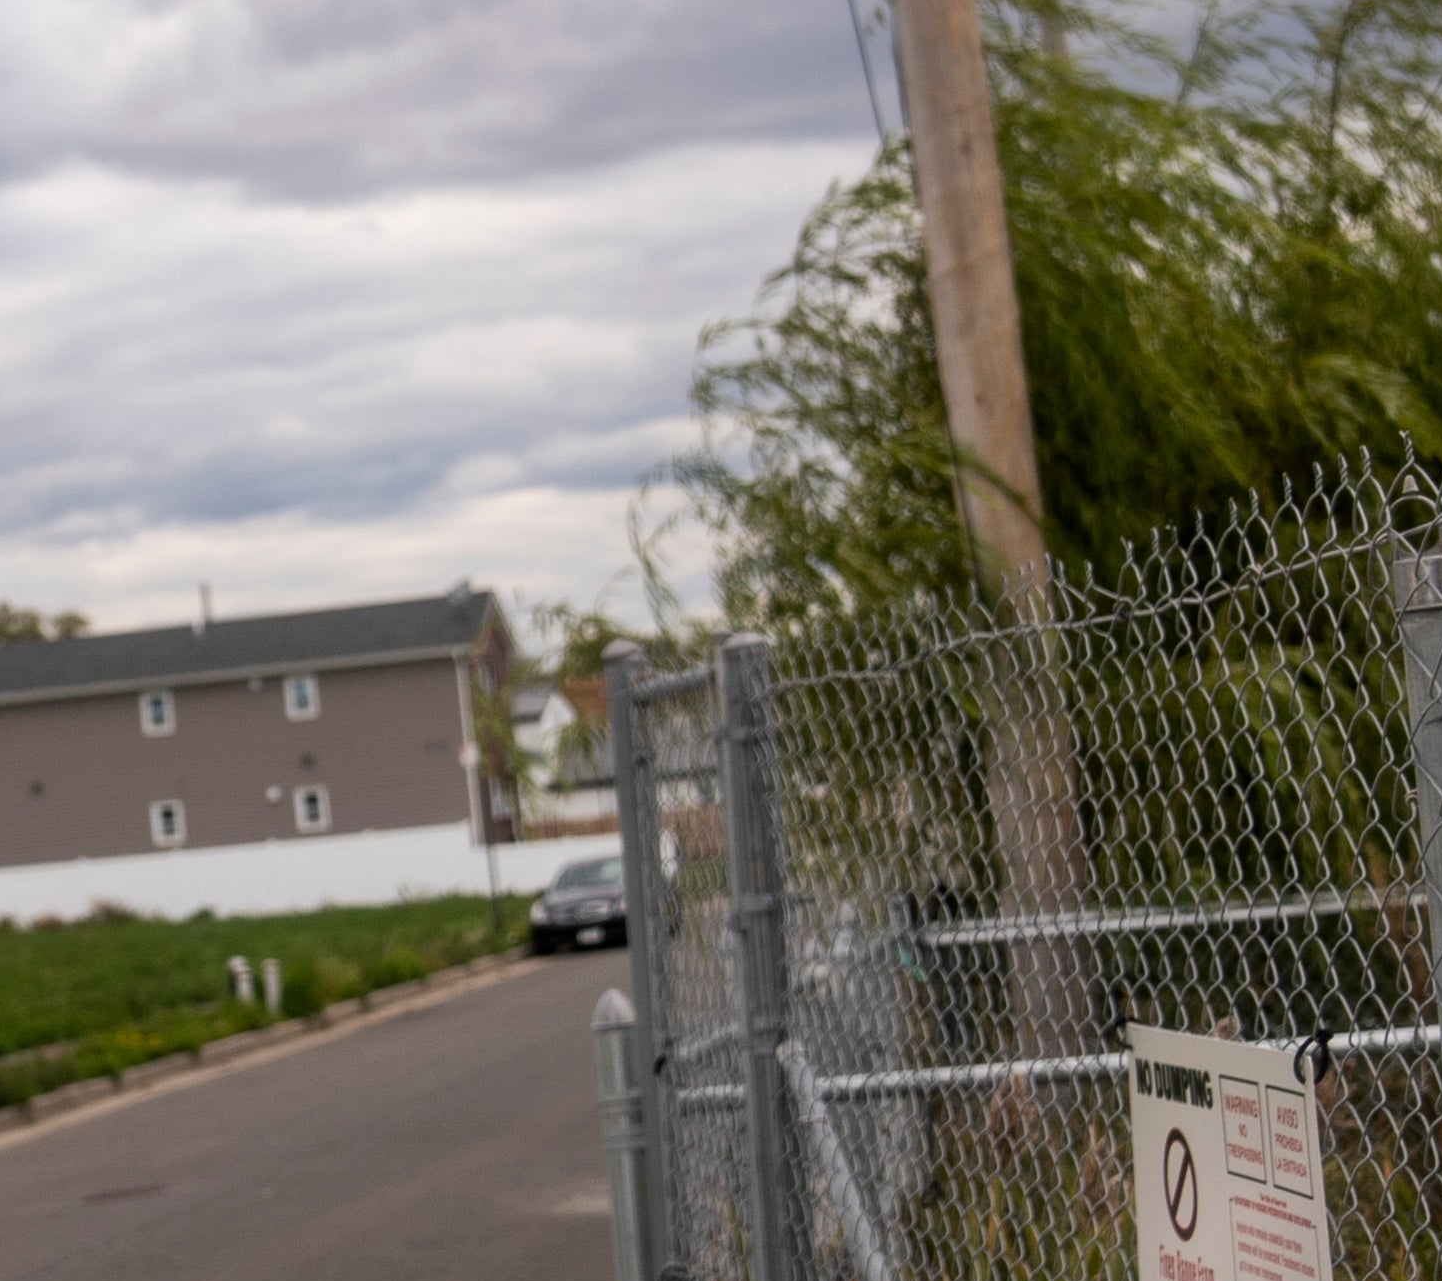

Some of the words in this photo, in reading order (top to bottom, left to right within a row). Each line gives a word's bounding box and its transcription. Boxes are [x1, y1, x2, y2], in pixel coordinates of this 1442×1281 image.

[1135, 1059, 1153, 1096] NO
[1153, 1061, 1214, 1110] DUMPING
[1224, 1094, 1258, 1119] WARNING
[1276, 1106, 1299, 1130] AVISO
[1159, 1244, 1176, 1281] Fines
